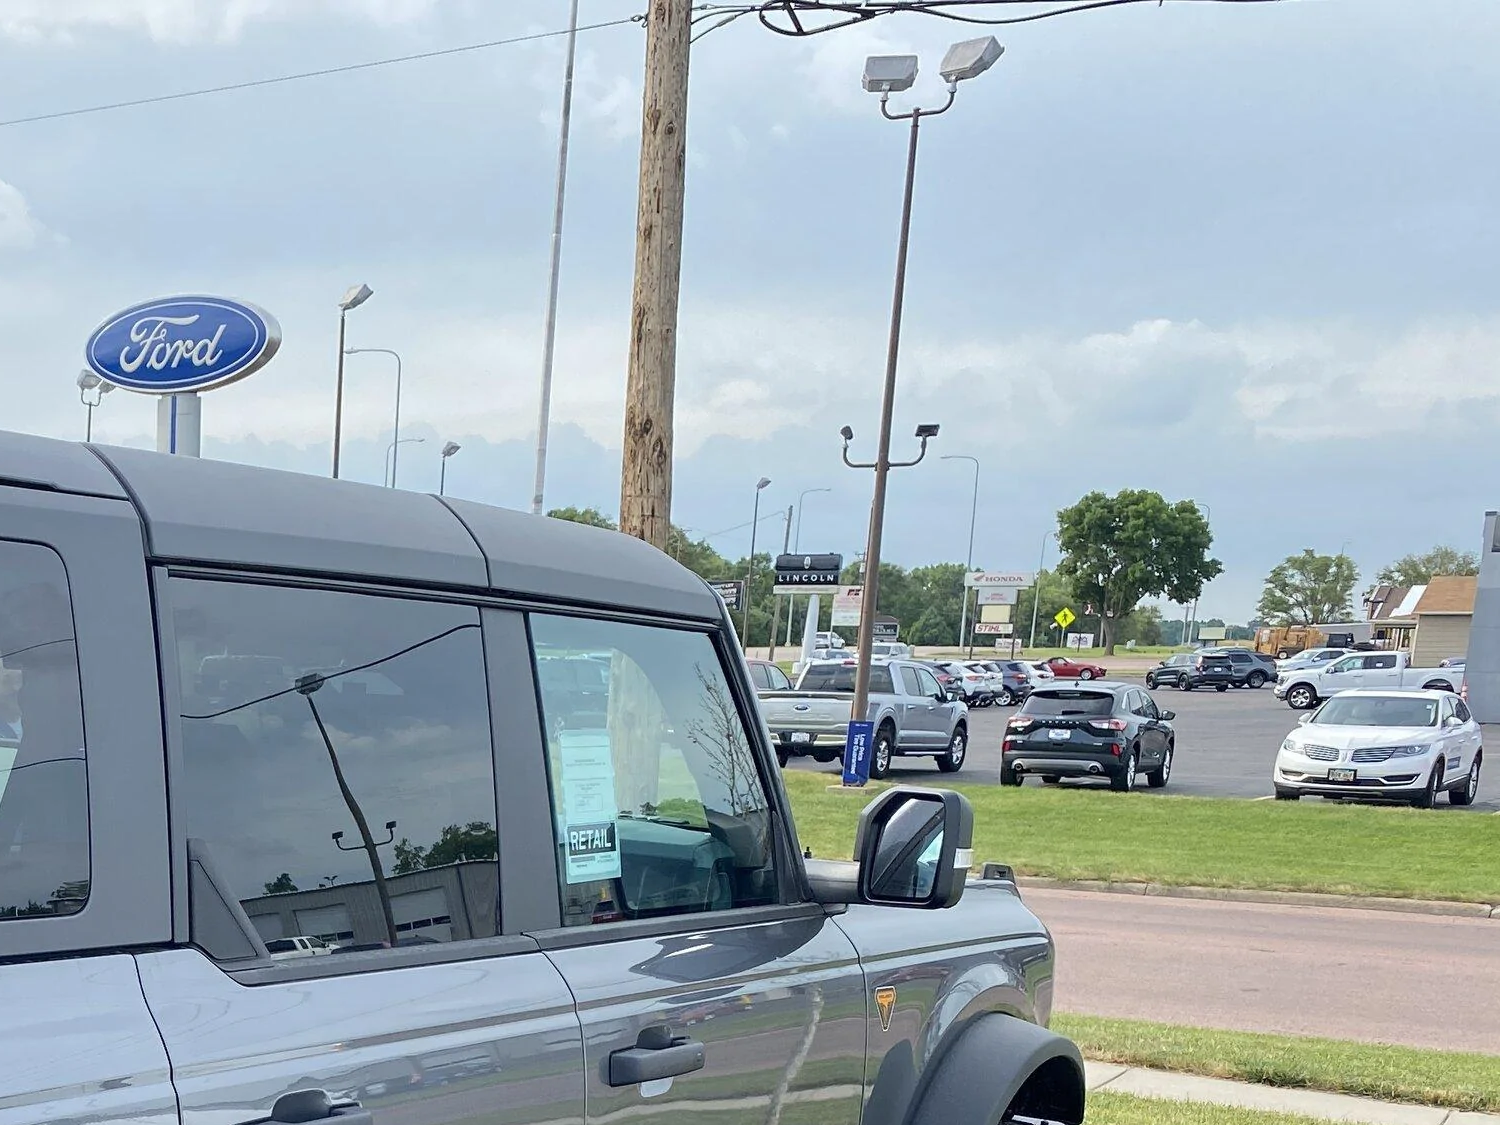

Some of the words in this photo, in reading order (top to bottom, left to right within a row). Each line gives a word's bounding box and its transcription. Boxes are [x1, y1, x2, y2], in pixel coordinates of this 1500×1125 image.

[120, 314, 227, 373] Ford
[778, 574, 835, 583] LINCOLN
[976, 624, 1001, 633] STIHL
[857, 746, 865, 762] Price
[570, 829, 612, 851] RETAIL
